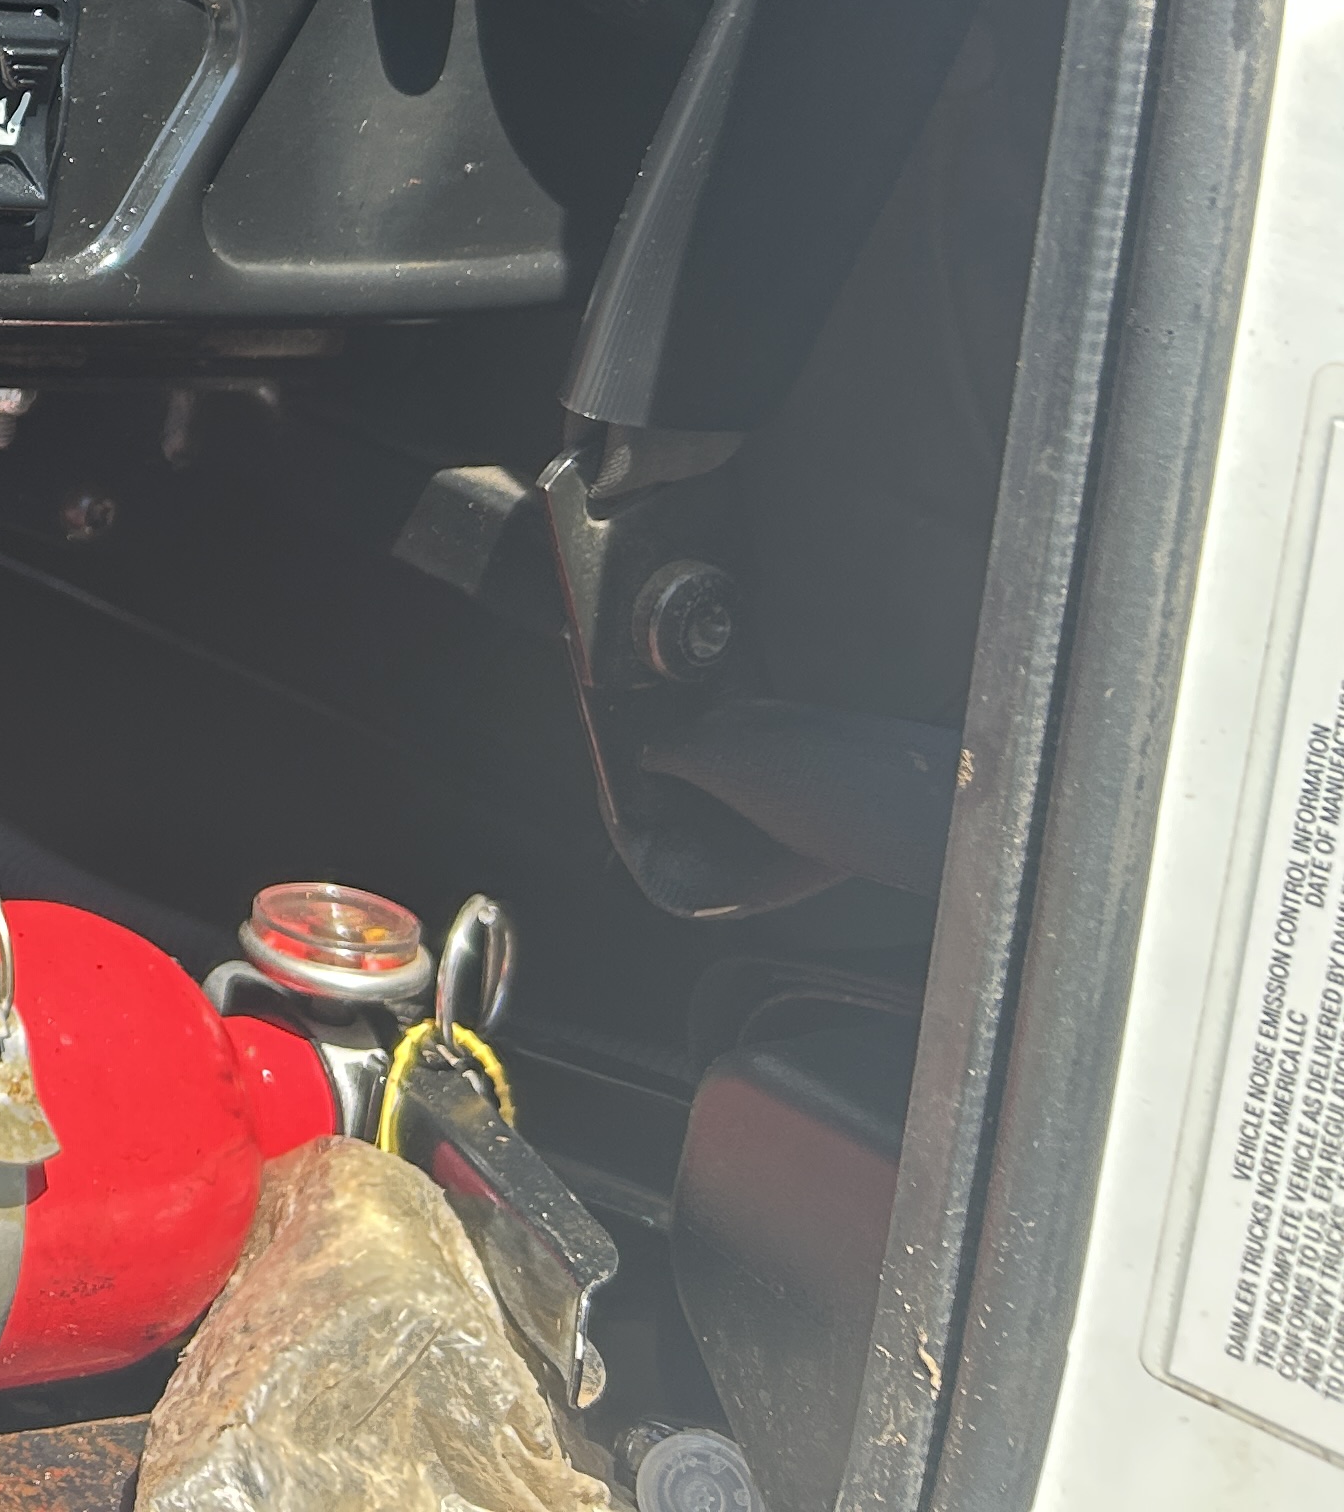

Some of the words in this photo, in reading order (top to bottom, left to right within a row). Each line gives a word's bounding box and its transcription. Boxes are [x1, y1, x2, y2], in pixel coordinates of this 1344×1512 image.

[1289, 722, 1332, 854] INFORMATION
[1313, 826, 1336, 855] OF
[1273, 856, 1308, 947] CONTROL
[1304, 856, 1332, 908] DATE
[1257, 948, 1292, 1041] EMISSION
[1281, 1008, 1308, 1047] LLC
[1245, 1041, 1276, 1102] NOISE
[1303, 986, 1344, 1094] DELIVERED
[1266, 1048, 1301, 1133] AMERICA
[1298, 1094, 1324, 1123] AS
[1232, 1102, 1264, 1181] VEHICLE
[1253, 1131, 1286, 1201] NORTH
[1283, 1121, 1318, 1202] VEHICLE
[1309, 1164, 1337, 1202] EPA
[1239, 1200, 1273, 1277] TRUCKS
[1260, 1204, 1303, 1325] INCOMPLETE
[1295, 1243, 1321, 1272] TO
[1222, 1278, 1258, 1361] DAIMLER
[1252, 1325, 1280, 1368] THIS
[1275, 1272, 1316, 1381] CONFORMS
[1307, 1283, 1338, 1347] HEAVY
[1298, 1346, 1326, 1392] AND
